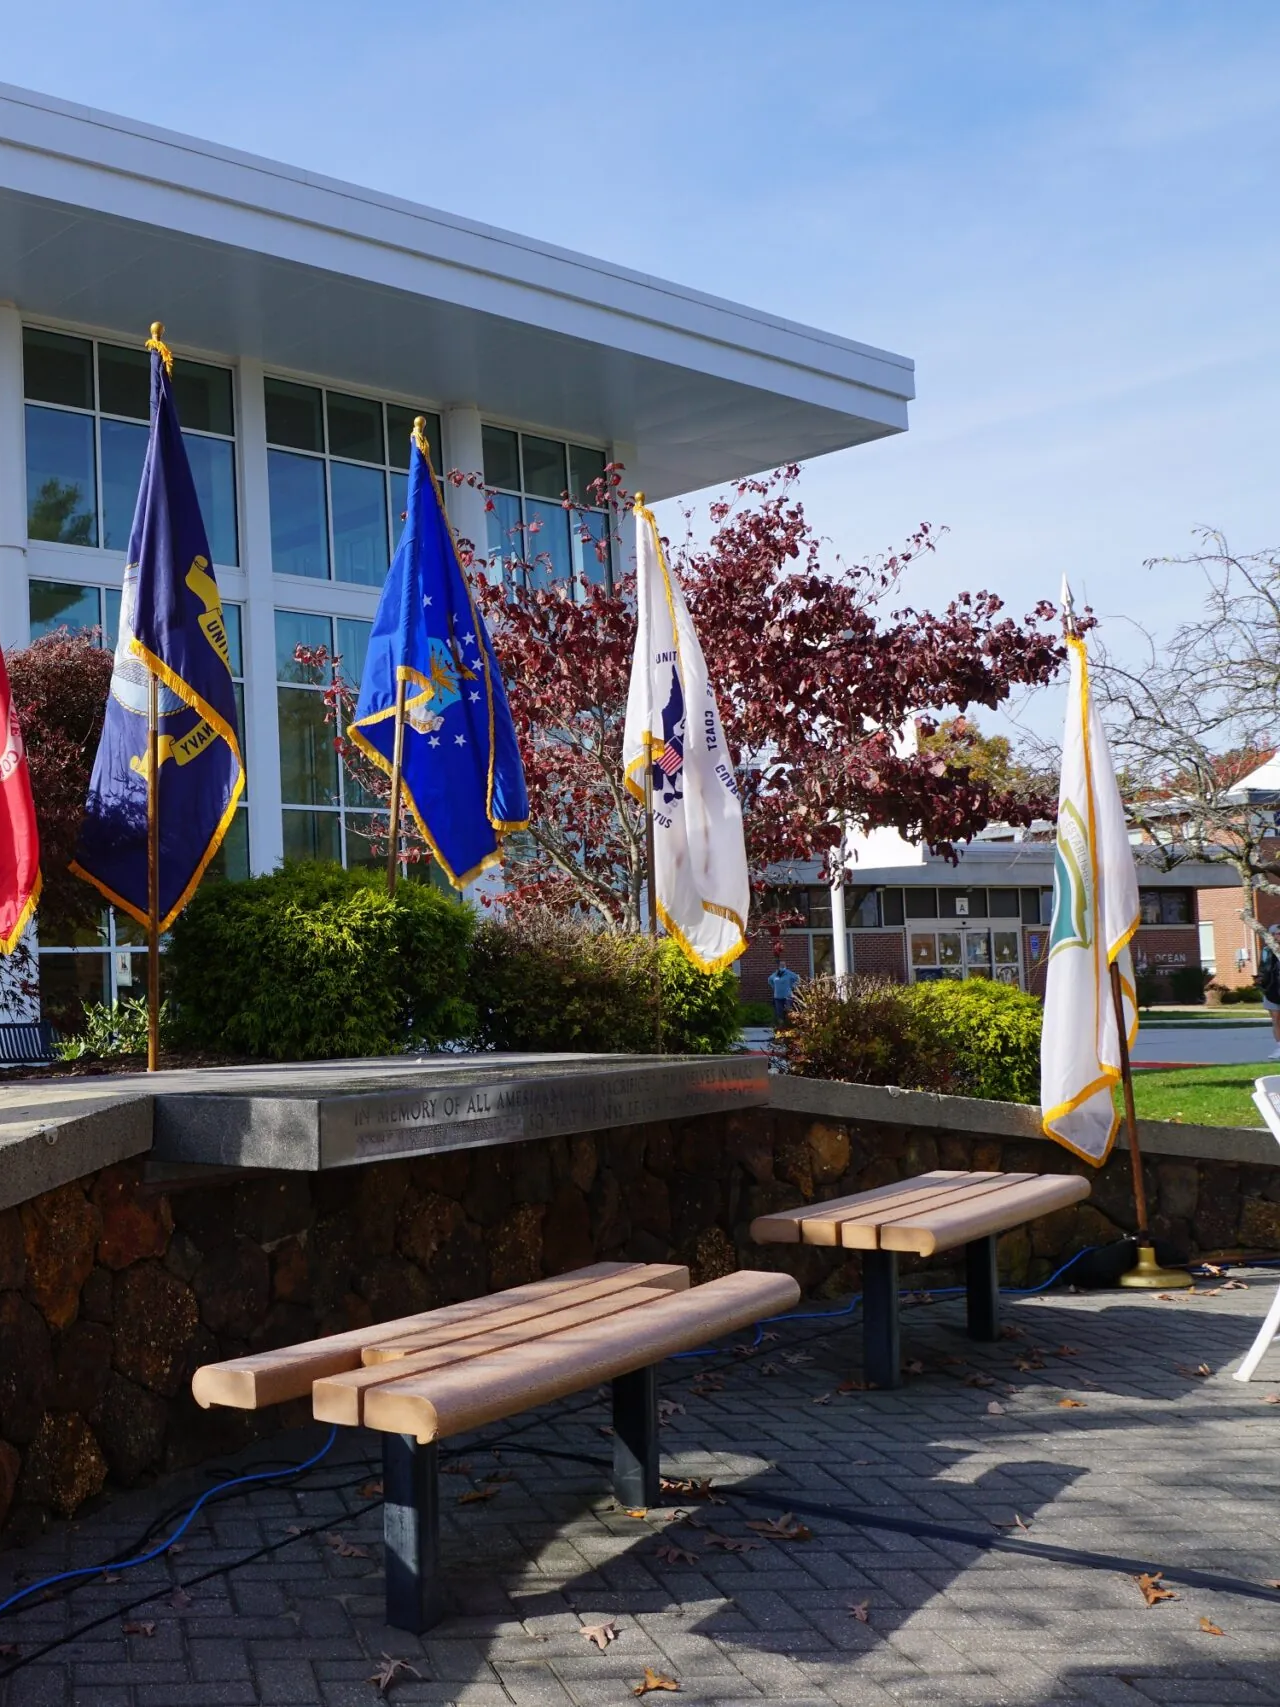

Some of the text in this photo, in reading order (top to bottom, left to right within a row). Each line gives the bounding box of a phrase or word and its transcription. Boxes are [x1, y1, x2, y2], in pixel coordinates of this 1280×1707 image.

[653, 809, 673, 829] TUS
[959, 904, 966, 913] A
[1155, 952, 1186, 963] OCEAN
[353, 1106, 370, 1126] IN
[377, 1098, 437, 1122] MEMORY
[443, 1095, 461, 1116] OF
[466, 1093, 492, 1113] ALL
